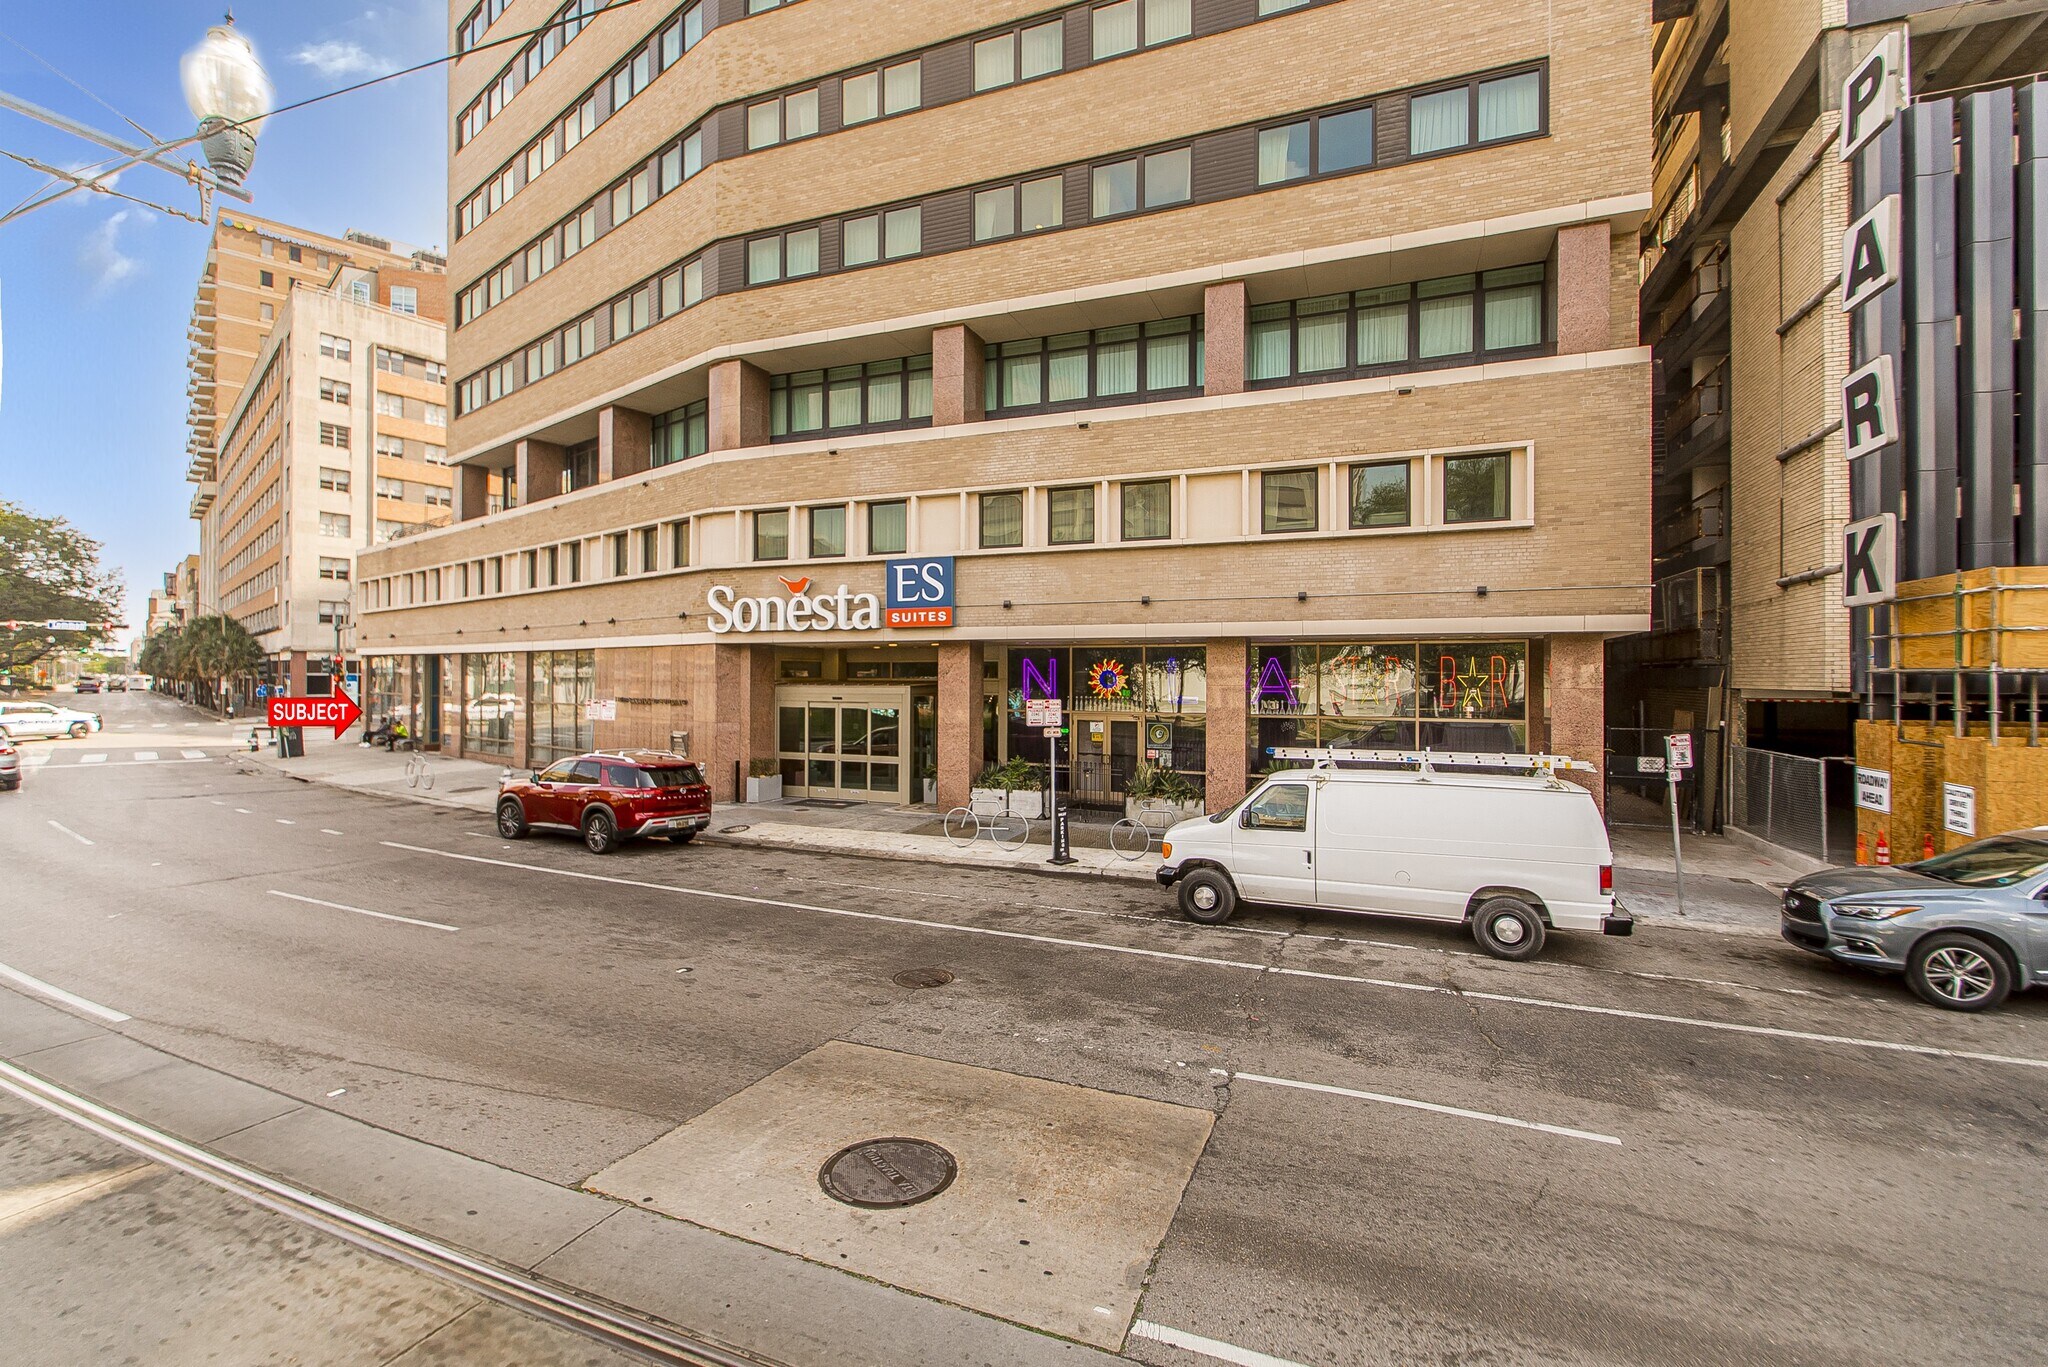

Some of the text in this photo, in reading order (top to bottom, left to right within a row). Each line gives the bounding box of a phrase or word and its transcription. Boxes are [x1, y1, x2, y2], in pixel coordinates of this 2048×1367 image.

[1845, 54, 1885, 598] PARK
[893, 562, 945, 602] ES
[707, 584, 881, 634] Sonesta
[891, 611, 947, 623] SUITES
[1862, 790, 1884, 806] AHEAD
